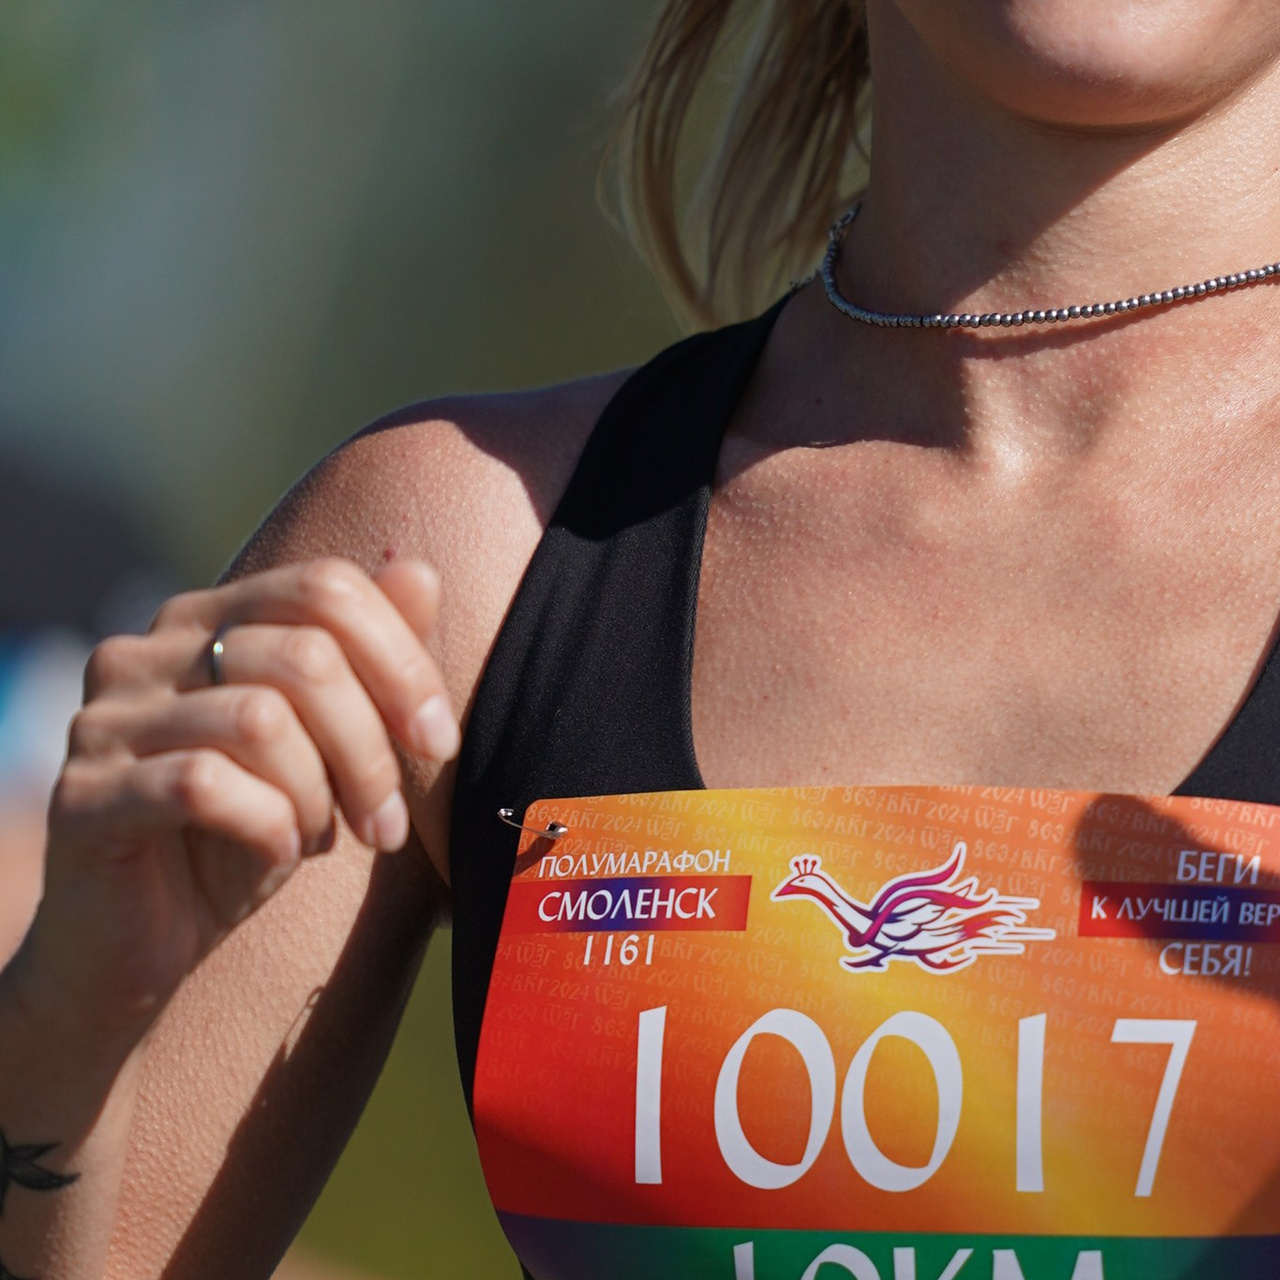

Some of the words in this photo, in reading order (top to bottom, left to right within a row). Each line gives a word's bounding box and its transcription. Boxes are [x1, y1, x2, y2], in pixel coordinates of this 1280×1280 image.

[538, 849, 732, 879] ПОЛУМАРАФОН
[1176, 850, 1263, 886] БЕГИ
[538, 887, 718, 922] СМОЛЕНСК
[1091, 895, 1109, 920] К
[1116, 895, 1231, 925] ЛУЧШЕЙ
[583, 934, 656, 966] 1161
[1158, 941, 1253, 978] СЕБЯ!
[634, 1005, 1198, 1197] 10017
